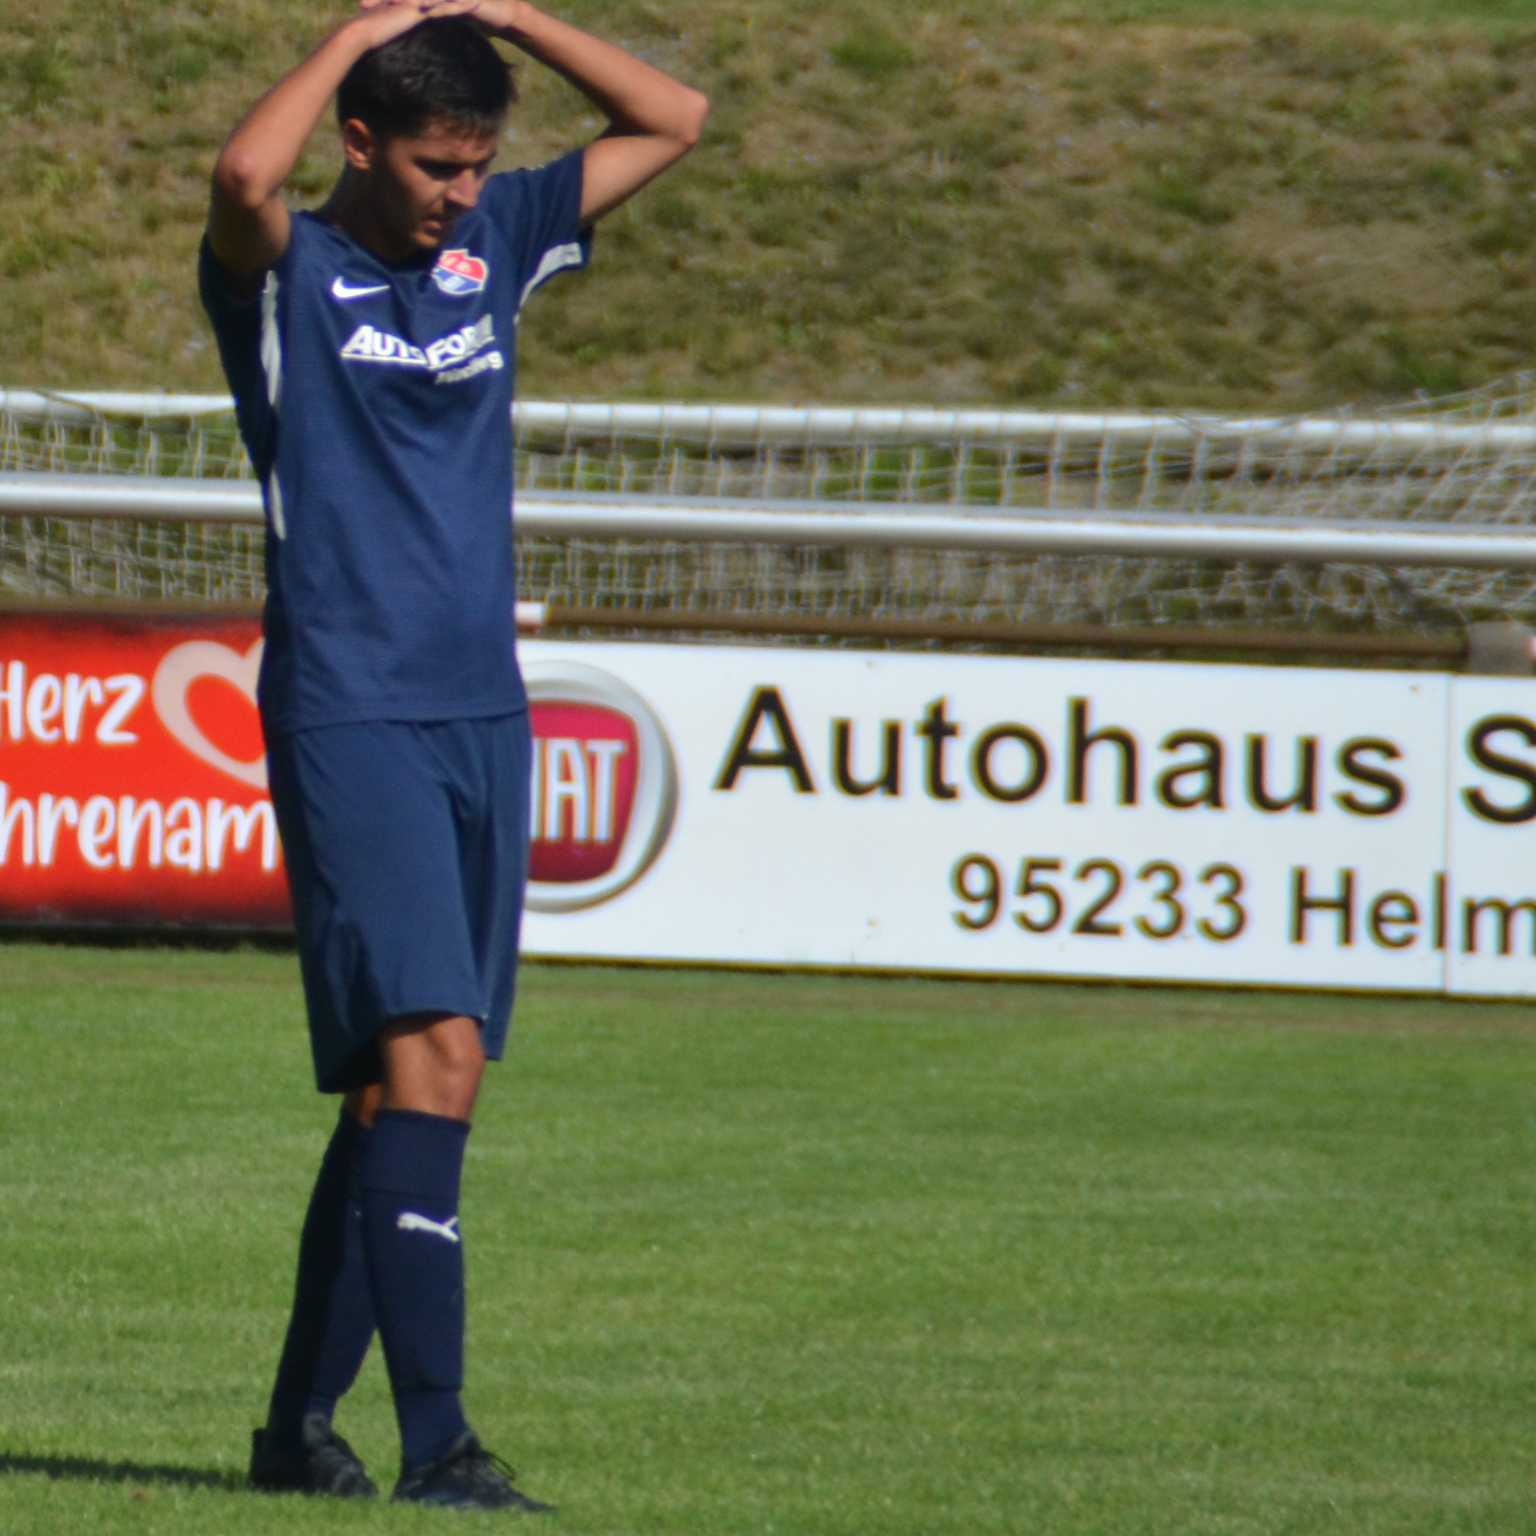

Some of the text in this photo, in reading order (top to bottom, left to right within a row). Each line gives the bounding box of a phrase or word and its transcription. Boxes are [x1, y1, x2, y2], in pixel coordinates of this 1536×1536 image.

[530, 737, 626, 842] IAT
[714, 684, 1405, 817] Autohaus
[952, 853, 1246, 942] 95233
